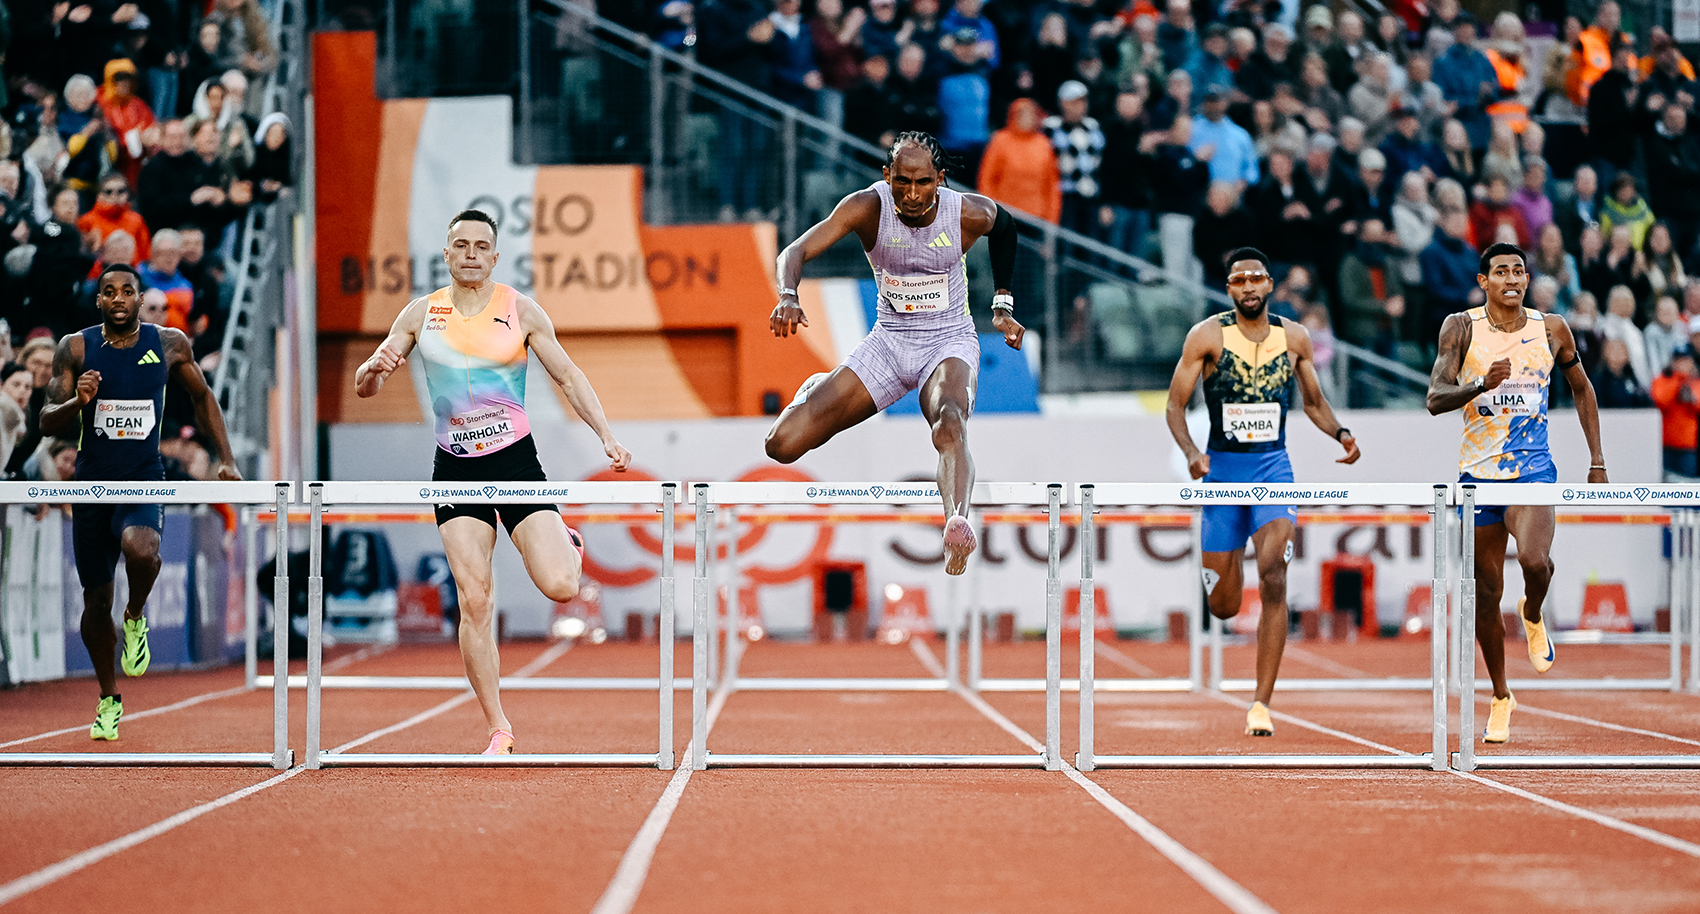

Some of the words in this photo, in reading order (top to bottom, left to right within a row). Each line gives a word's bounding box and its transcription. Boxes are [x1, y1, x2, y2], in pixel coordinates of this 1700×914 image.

[464, 193, 595, 237] OSLO
[512, 250, 721, 292] STADION
[902, 278, 944, 288] Storebrand
[886, 290, 904, 301] DOS
[904, 291, 941, 301] SANTOS
[1493, 394, 1525, 406] LIMA
[115, 403, 152, 412] Storebrand
[466, 408, 505, 424] Storebrand
[106, 417, 142, 429] DEAN
[1231, 420, 1273, 431] SAMBA
[452, 421, 509, 443] WARHOLM
[485, 437, 505, 448] EXTRA
[106, 488, 143, 497] DIAMOND
[145, 488, 177, 497] LEAGUE
[498, 489, 536, 497] DIAMOND
[537, 488, 569, 497] LEAGUE
[885, 488, 923, 497] DIAMOND
[924, 489, 943, 497] LEA
[1269, 490, 1312, 499] DIAMOND
[1313, 490, 1349, 499] LEAGUE
[1651, 491, 1693, 499] DIAMOND
[1284, 545, 1292, 557] 5
[1204, 572, 1211, 585] 5
